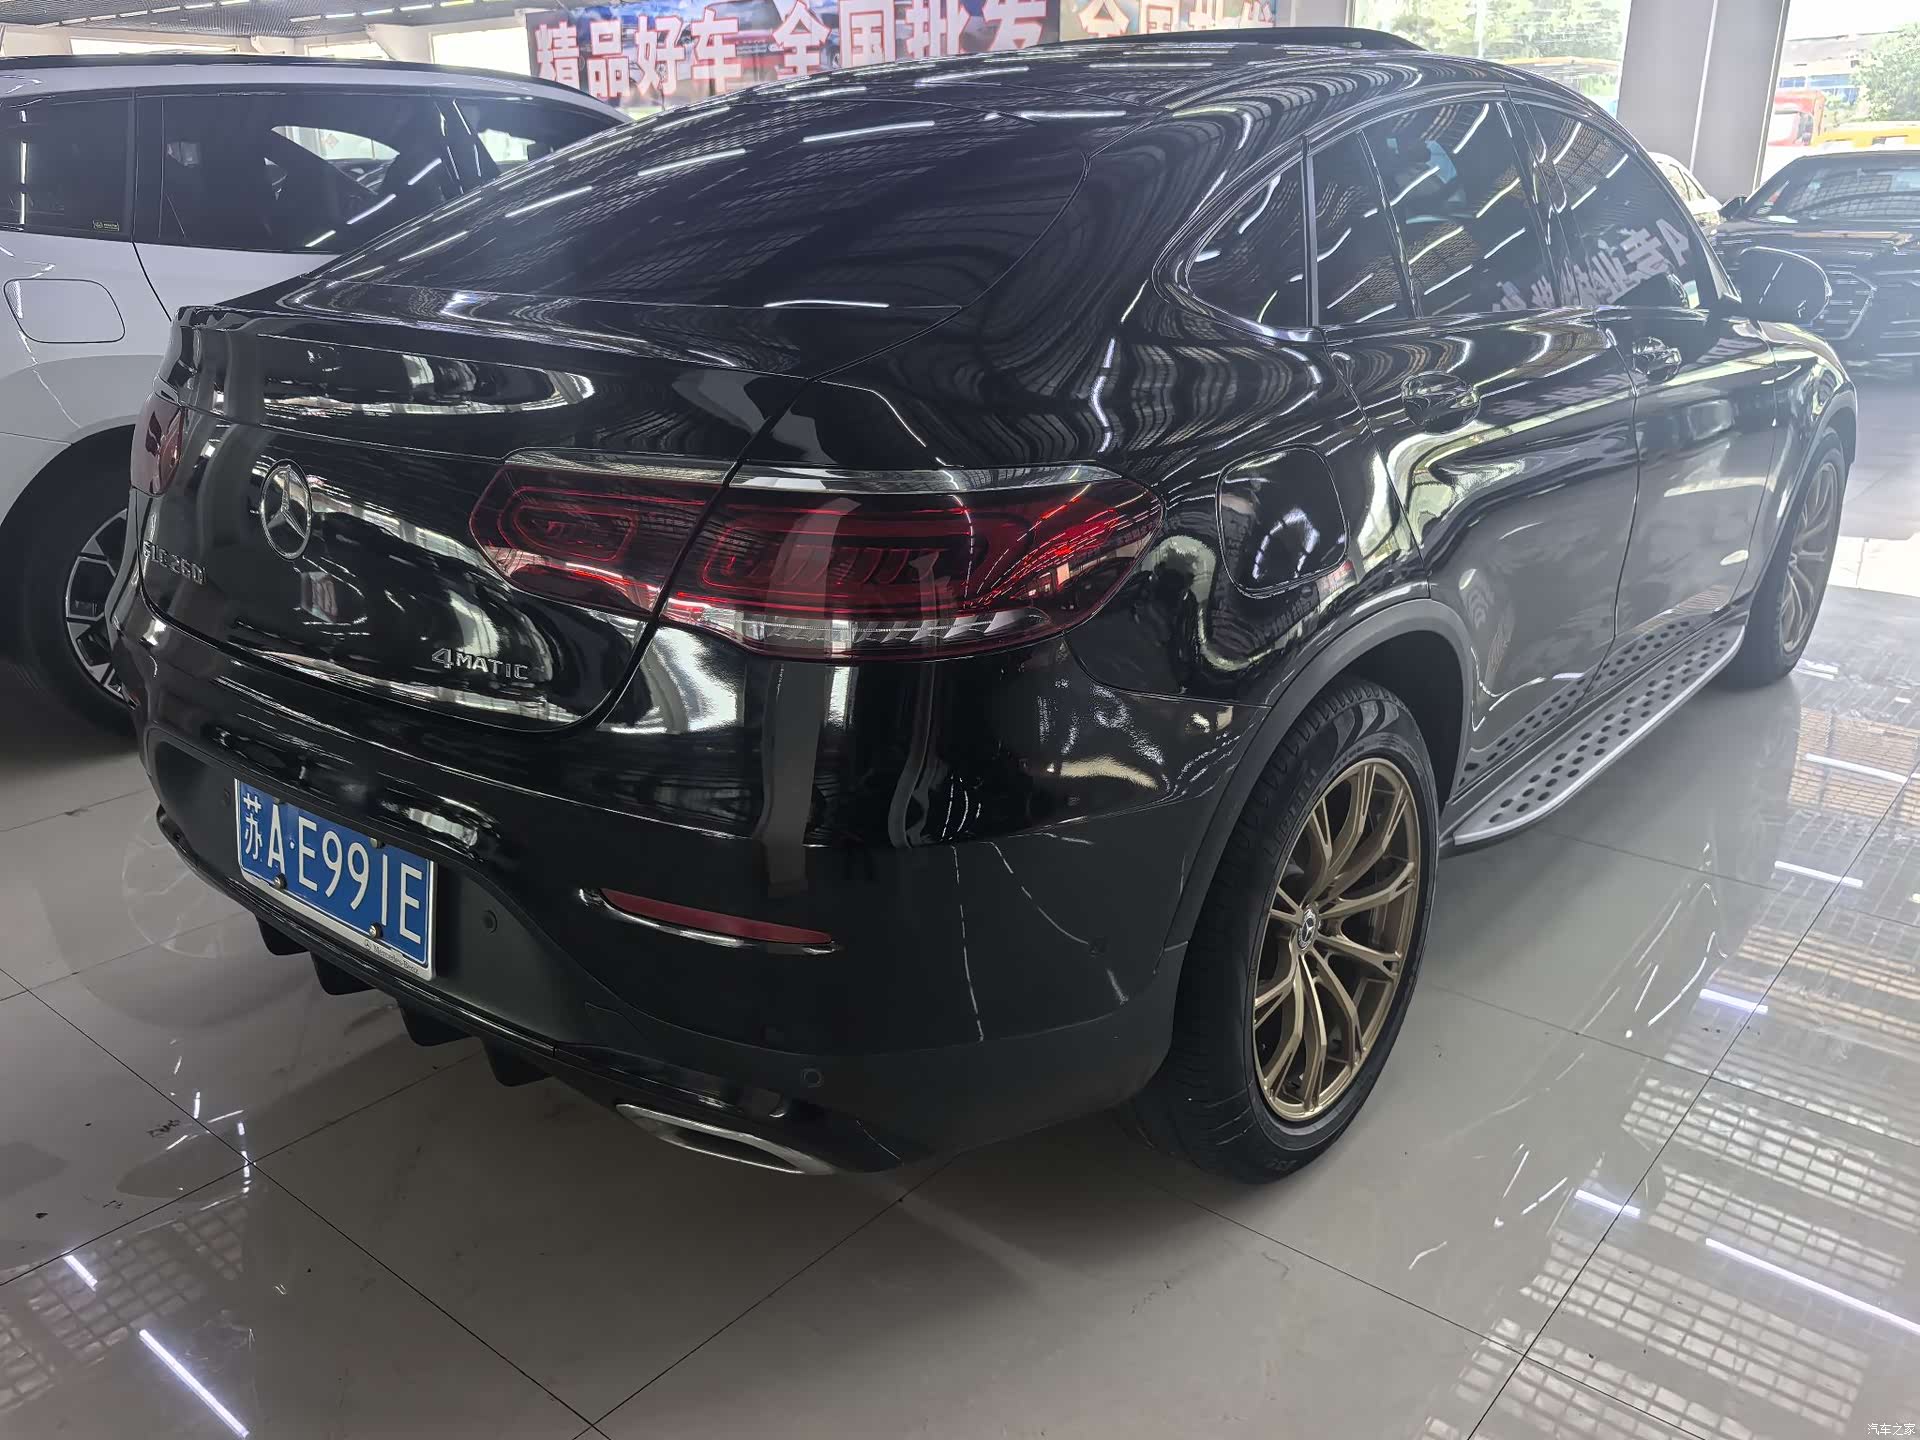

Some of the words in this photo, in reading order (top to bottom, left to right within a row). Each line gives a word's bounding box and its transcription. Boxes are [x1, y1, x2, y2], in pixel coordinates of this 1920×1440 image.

[534, 8, 741, 98] 精品好车
[431, 648, 528, 680] 4MATIC
